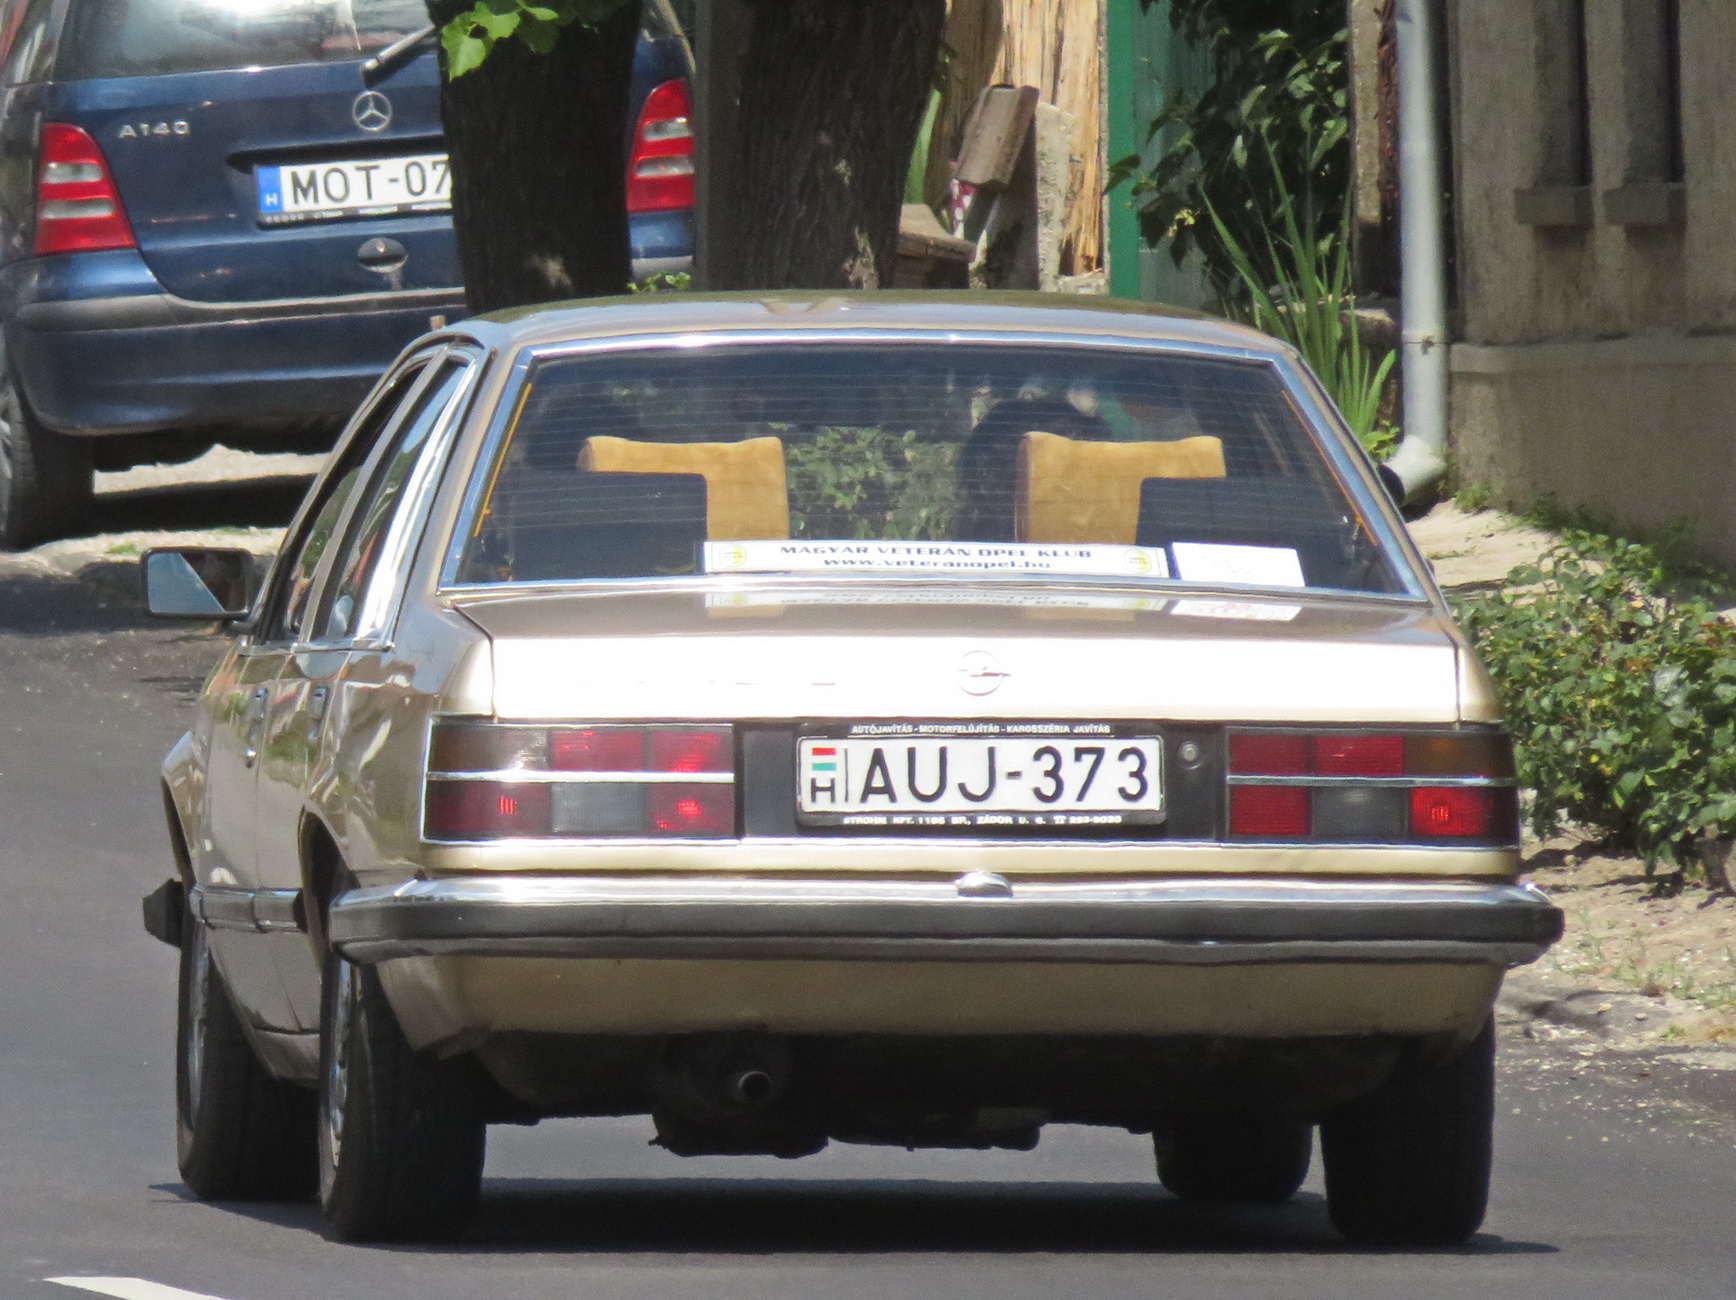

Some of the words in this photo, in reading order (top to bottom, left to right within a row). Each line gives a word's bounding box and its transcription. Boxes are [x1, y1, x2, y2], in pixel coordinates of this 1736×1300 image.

[118, 121, 190, 139] A140
[265, 192, 279, 207] H
[290, 160, 451, 206] MOT-07
[780, 546, 869, 555] MAGYAR
[978, 548, 1026, 558] OPEL
[1037, 549, 1092, 559] KLUB
[824, 558, 1051, 570] www.veteranopel.hu
[851, 723, 913, 734] AUTÓJAVÍTÁS
[1006, 723, 1070, 734] KAROSSZÉRIA
[1073, 723, 1111, 734] JAVÍTÁS
[811, 777, 837, 804] H
[859, 745, 1149, 804] AUJ-373
